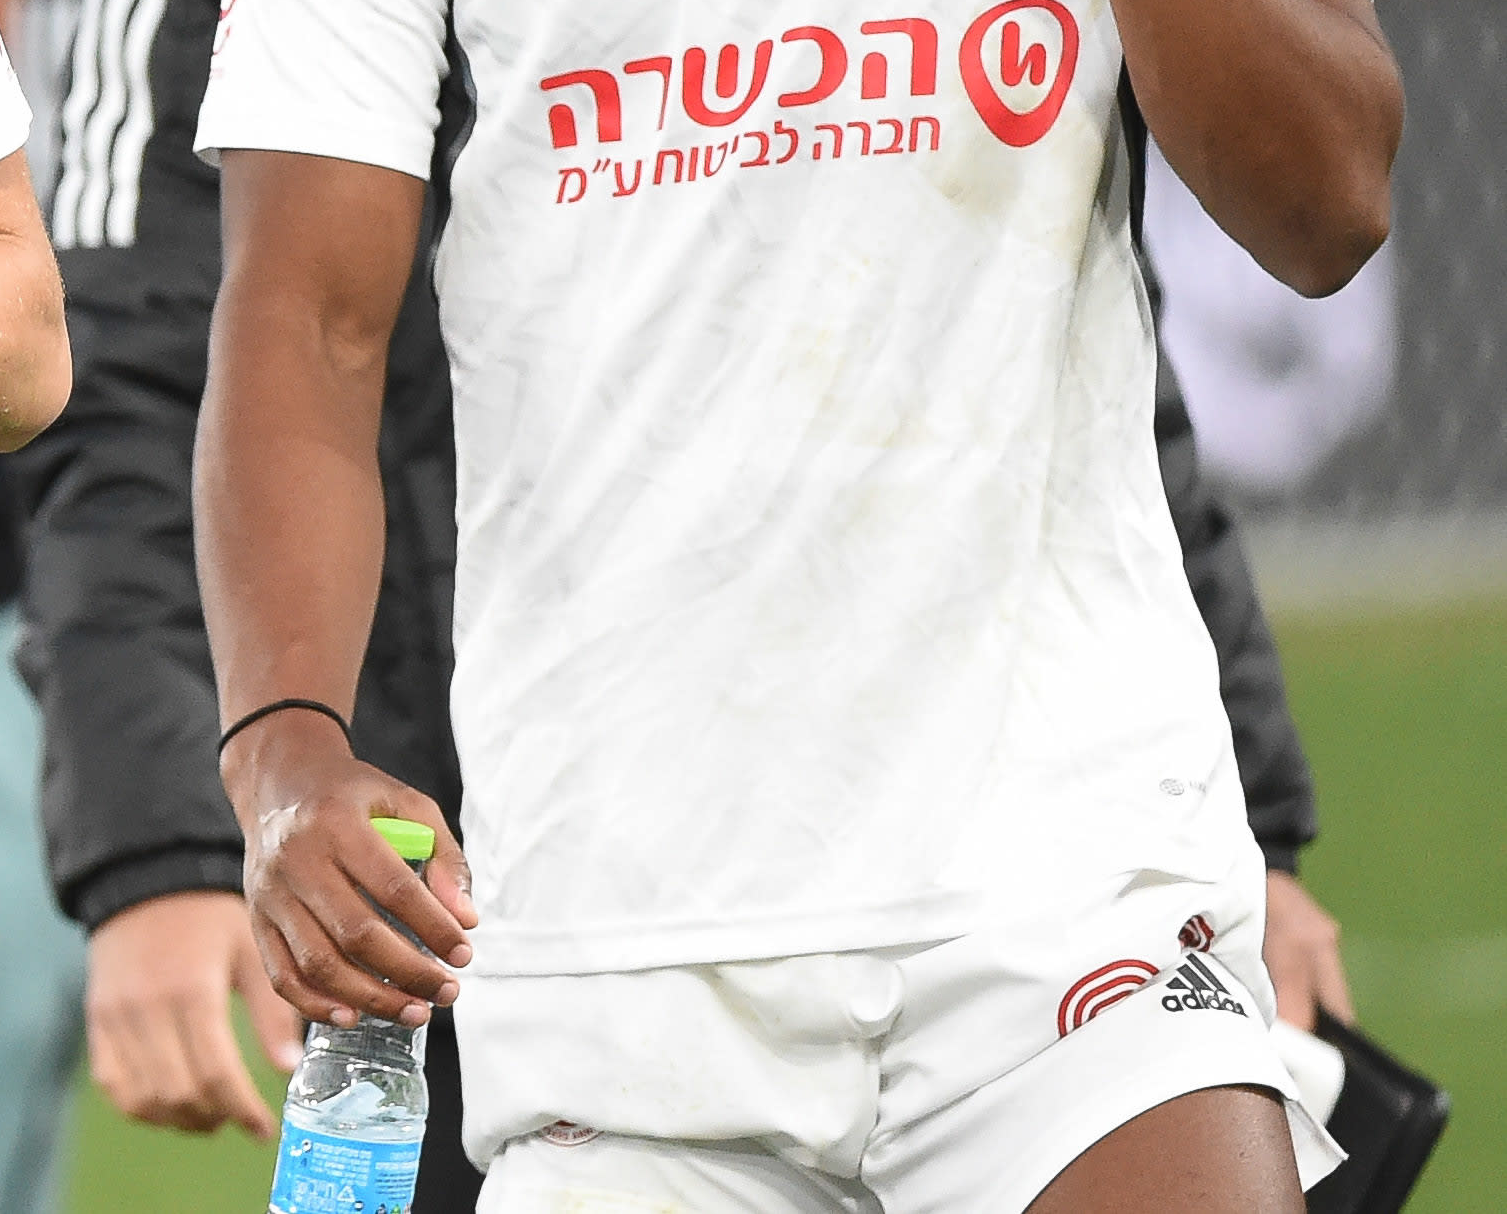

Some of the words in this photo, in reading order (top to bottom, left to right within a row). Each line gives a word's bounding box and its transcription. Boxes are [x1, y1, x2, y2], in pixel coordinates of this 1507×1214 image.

[540, 17, 938, 149] הכשרה
[652, 120, 799, 186] לביטוח
[811, 116, 940, 160] חברה
[1161, 989, 1249, 1018] adidas
